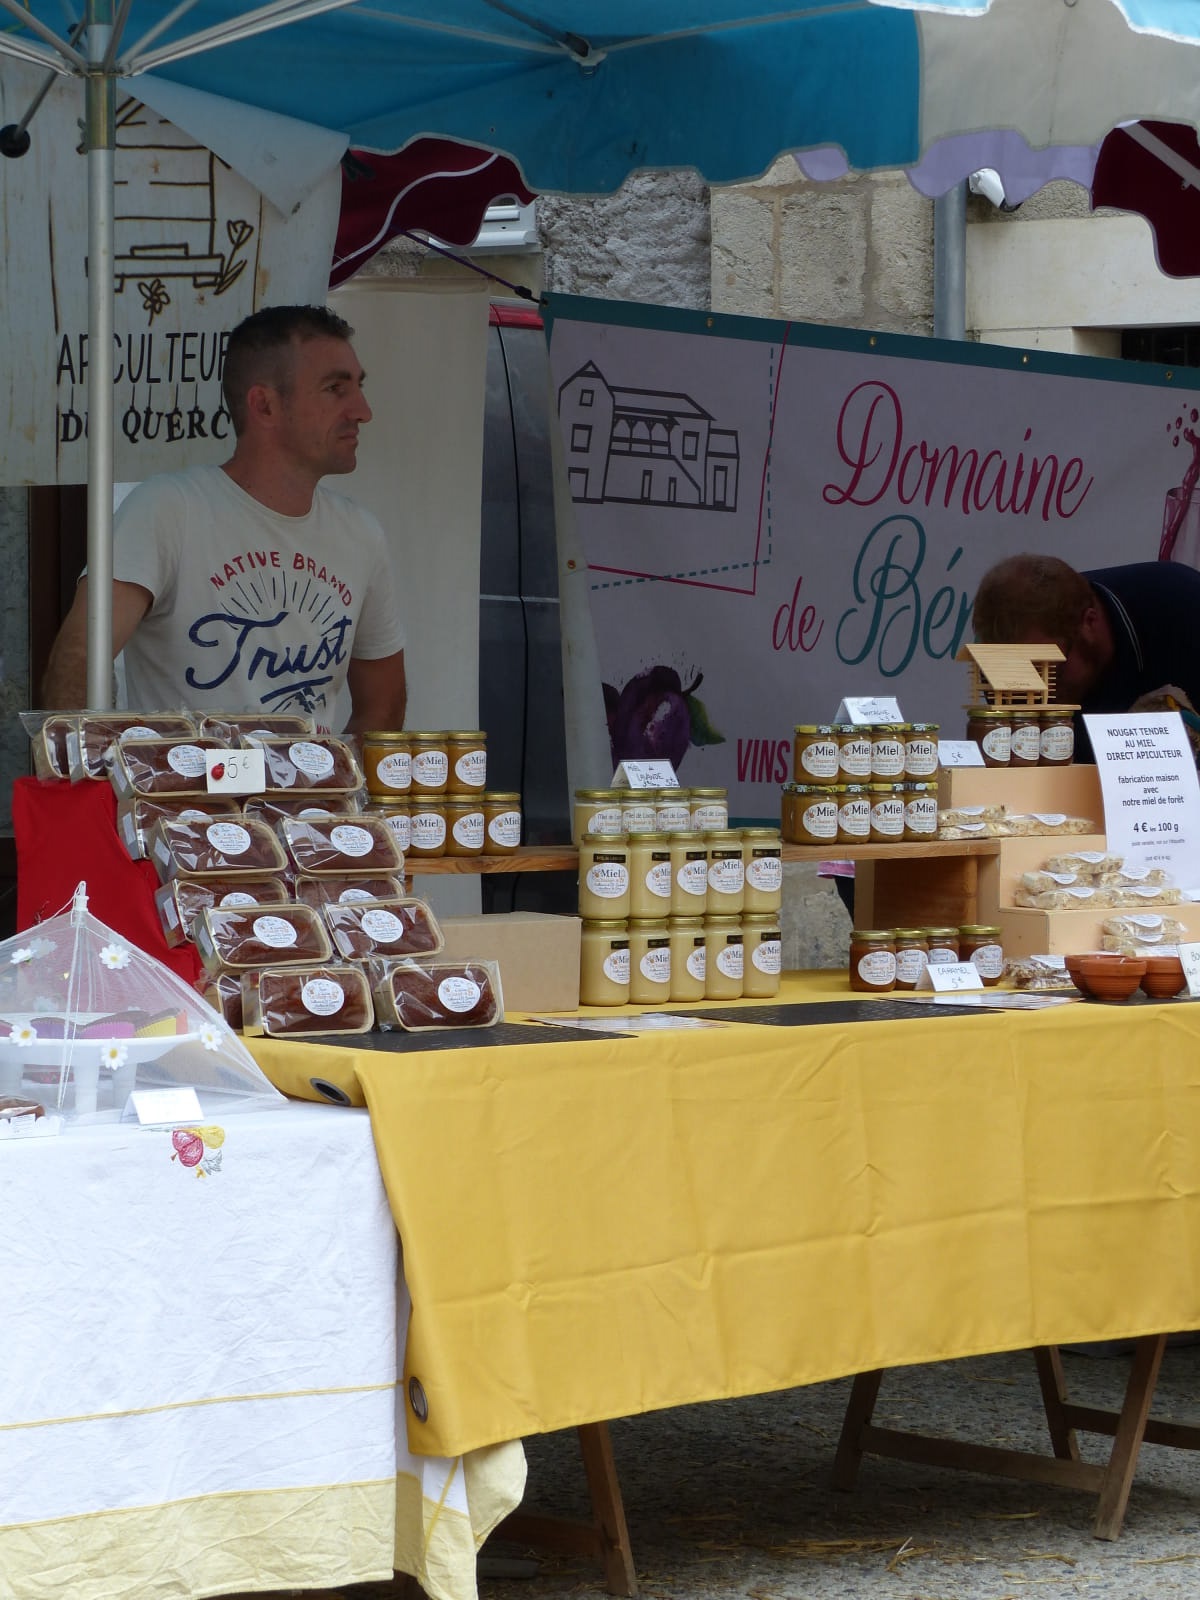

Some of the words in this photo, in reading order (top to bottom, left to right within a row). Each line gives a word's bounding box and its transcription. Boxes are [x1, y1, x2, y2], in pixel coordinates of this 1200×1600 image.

[57, 332, 232, 385] APCULTEUR
[60, 410, 88, 442] D
[122, 407, 231, 444] QUERC
[822, 380, 1094, 521] Domaine
[210, 551, 281, 591] NATIVE
[293, 552, 352, 607] BRAND
[772, 576, 824, 652] de
[185, 612, 352, 690] Trust
[1107, 728, 1138, 737] NOUGAT
[1139, 727, 1169, 735] TENDRE
[1125, 740, 1135, 748] AU
[1137, 739, 1156, 748] MIEL
[815, 746, 836, 756] Miel
[876, 745, 898, 756] Miel
[910, 744, 932, 755] Miel
[1106, 751, 1134, 761] DIRECT
[1136, 749, 1182, 760] APICULTEUR
[392, 758, 410, 767] Miel
[426, 756, 444, 765] Miel
[736, 738, 791, 784] VINS
[1118, 774, 1154, 784] fabrication
[1156, 774, 1180, 782] maison
[1144, 786, 1159, 794] avec
[1122, 798, 1140, 806] notre
[1142, 797, 1156, 805] miel
[1158, 796, 1166, 804] de
[1168, 796, 1184, 804] forêt
[883, 804, 902, 814] Miel
[916, 803, 936, 813] Miel
[392, 820, 409, 829] Miel
[418, 818, 439, 828] Miel
[1133, 822, 1139, 832] 4
[1142, 822, 1148, 832] €
[1158, 822, 1172, 832] 100
[1174, 823, 1178, 832] g
[722, 860, 740, 870] Miel
[600, 869, 621, 878] Miel
